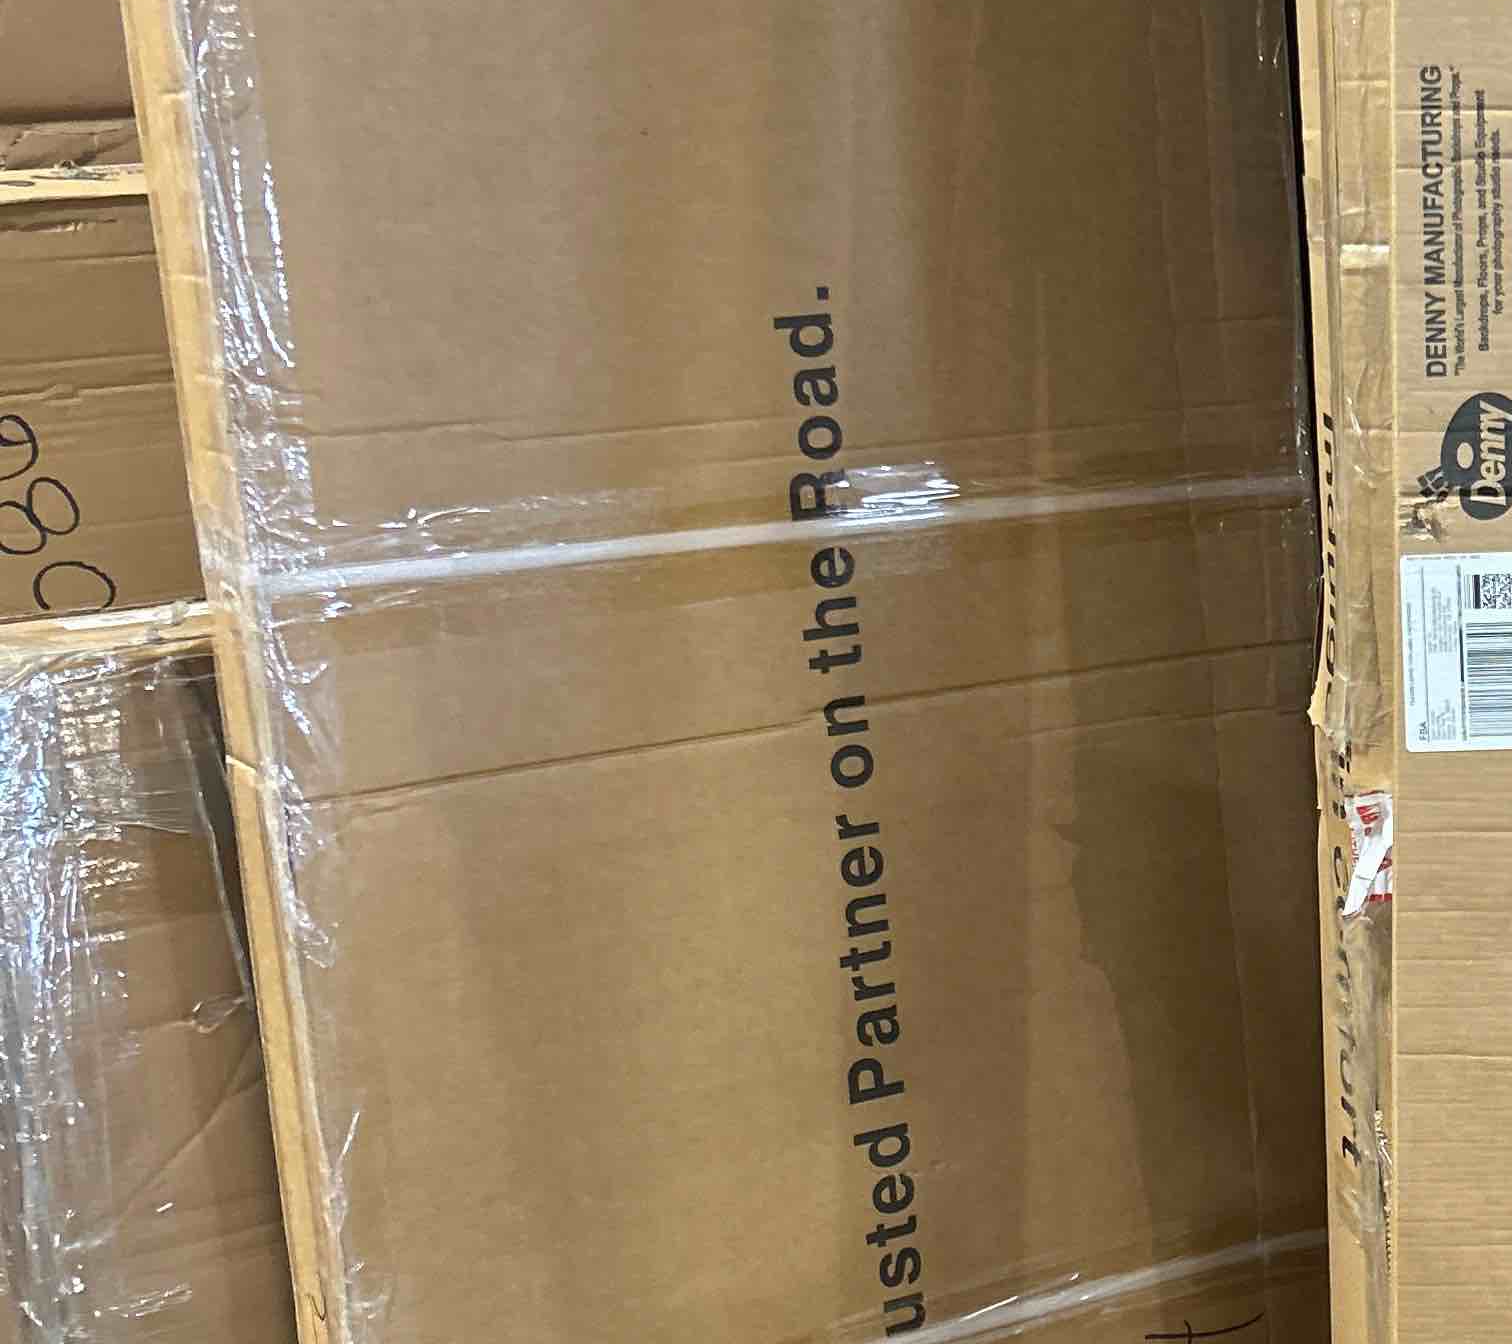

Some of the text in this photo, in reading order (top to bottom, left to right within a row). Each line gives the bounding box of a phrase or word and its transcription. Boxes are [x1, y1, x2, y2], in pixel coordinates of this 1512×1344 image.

[1420, 65, 1449, 378] DENNY MANUFACTURING
[773, 285, 844, 522] Road.
[1469, 399, 1512, 506] Denny
[802, 544, 863, 674] the
[826, 694, 875, 789] on
[834, 810, 907, 1105] Partner
